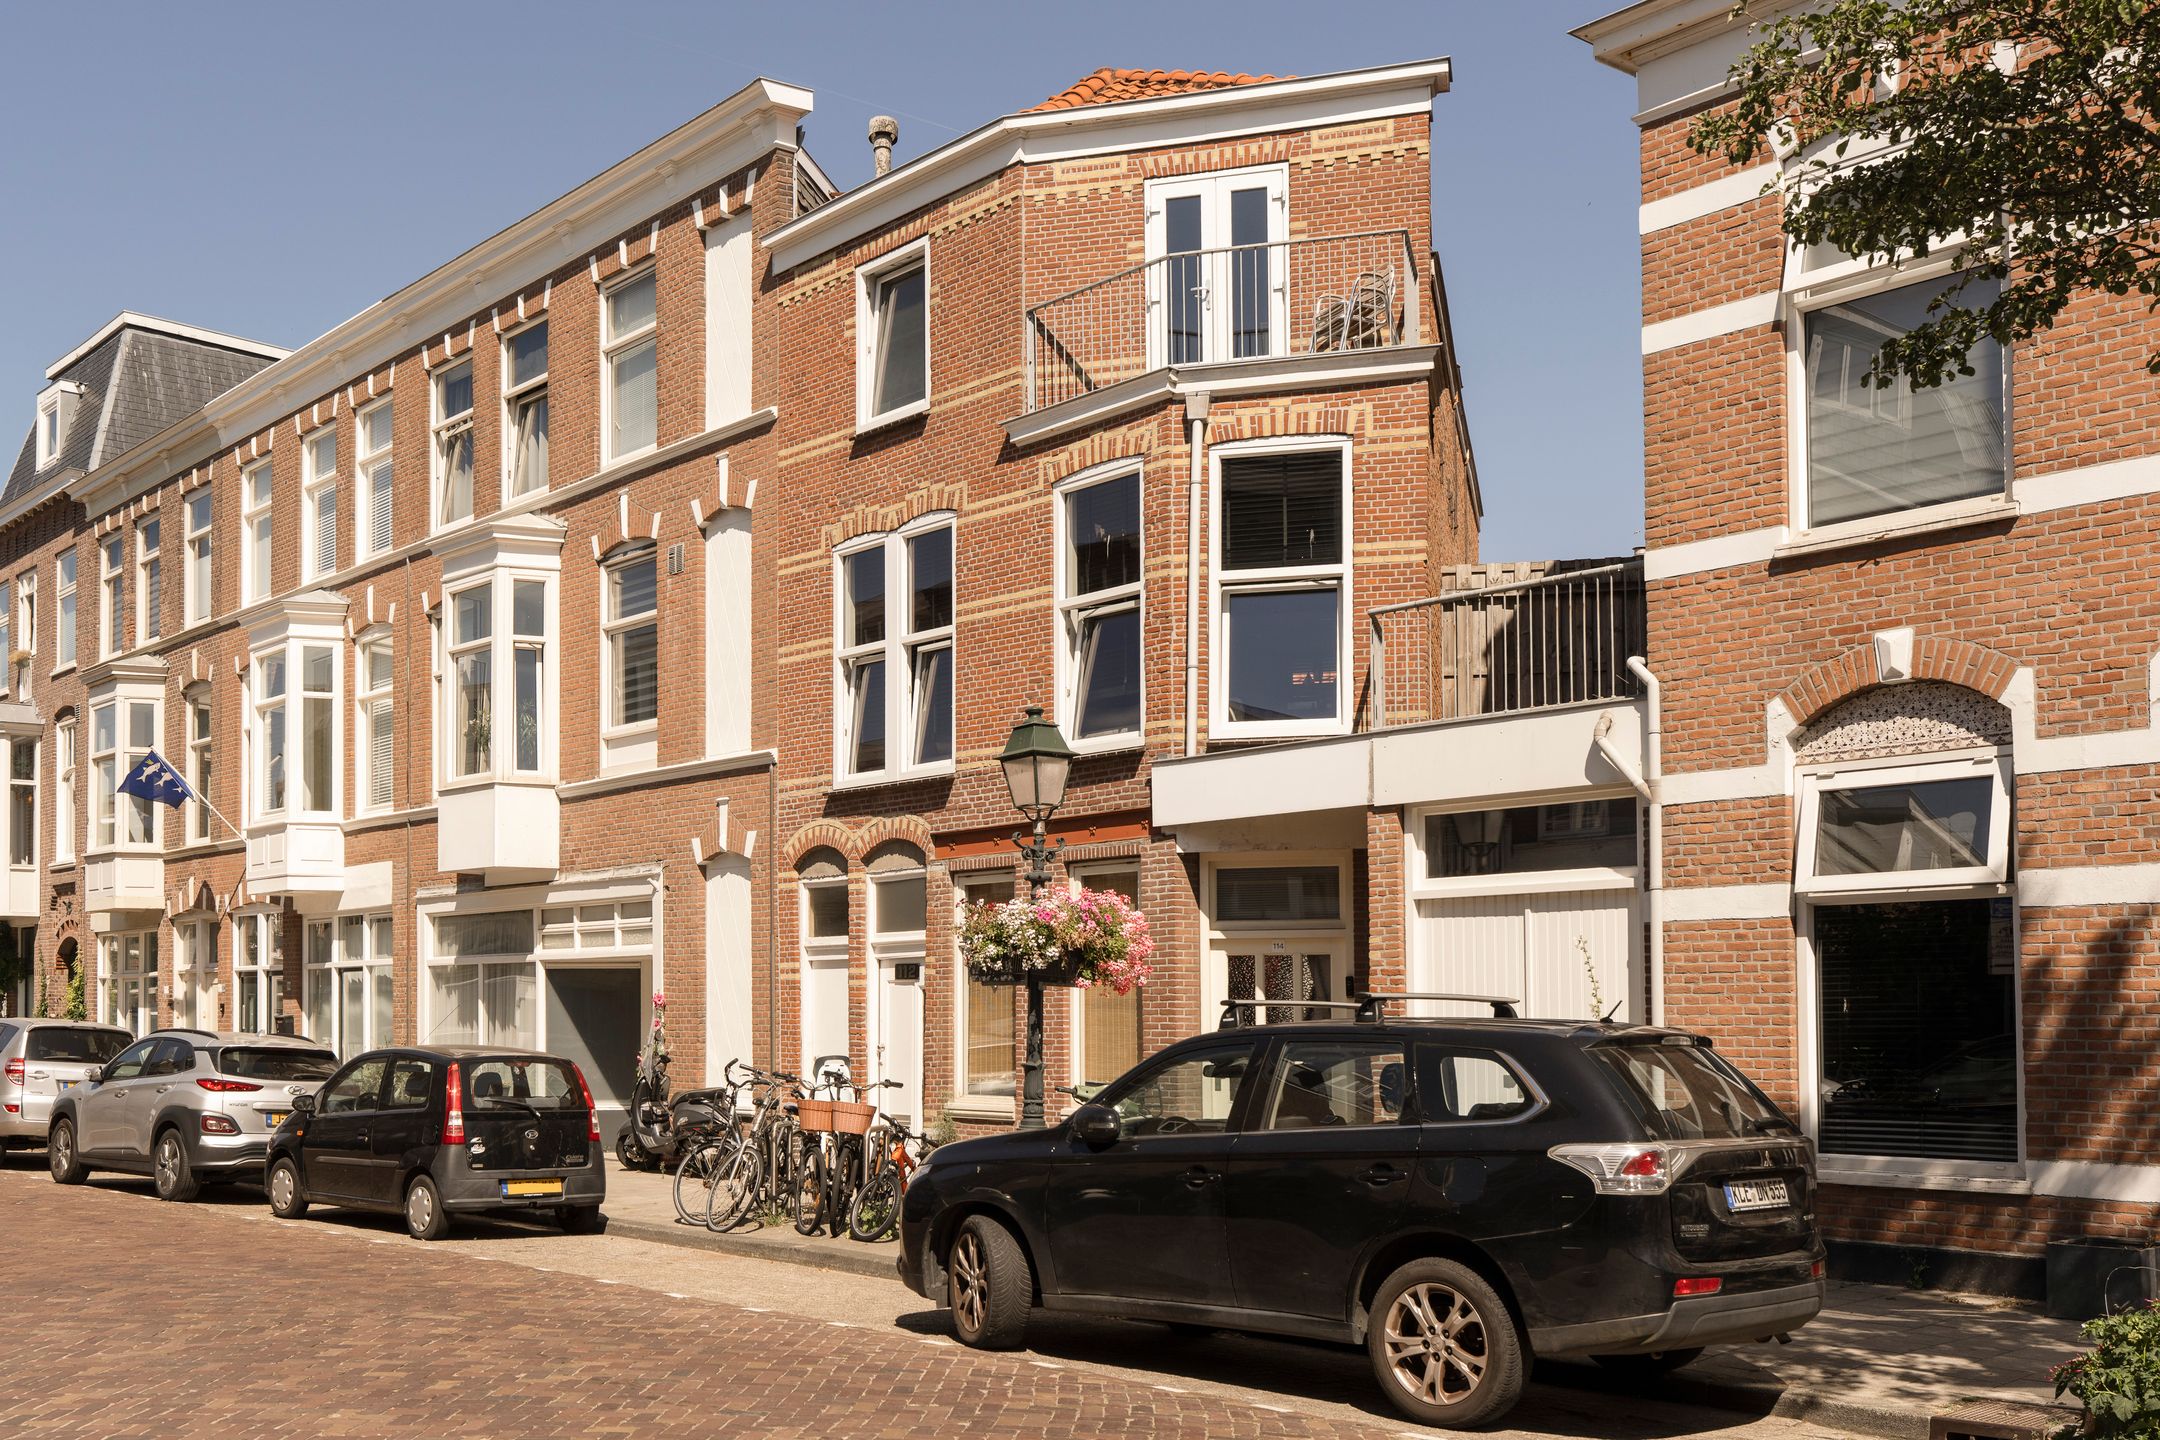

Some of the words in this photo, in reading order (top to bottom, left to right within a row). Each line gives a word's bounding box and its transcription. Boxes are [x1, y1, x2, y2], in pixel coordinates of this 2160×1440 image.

[897, 964, 916, 978] 112
[1730, 1183, 1752, 1204] KLE
[1755, 1181, 1770, 1202] DN
[1768, 1180, 1787, 1200] 555
